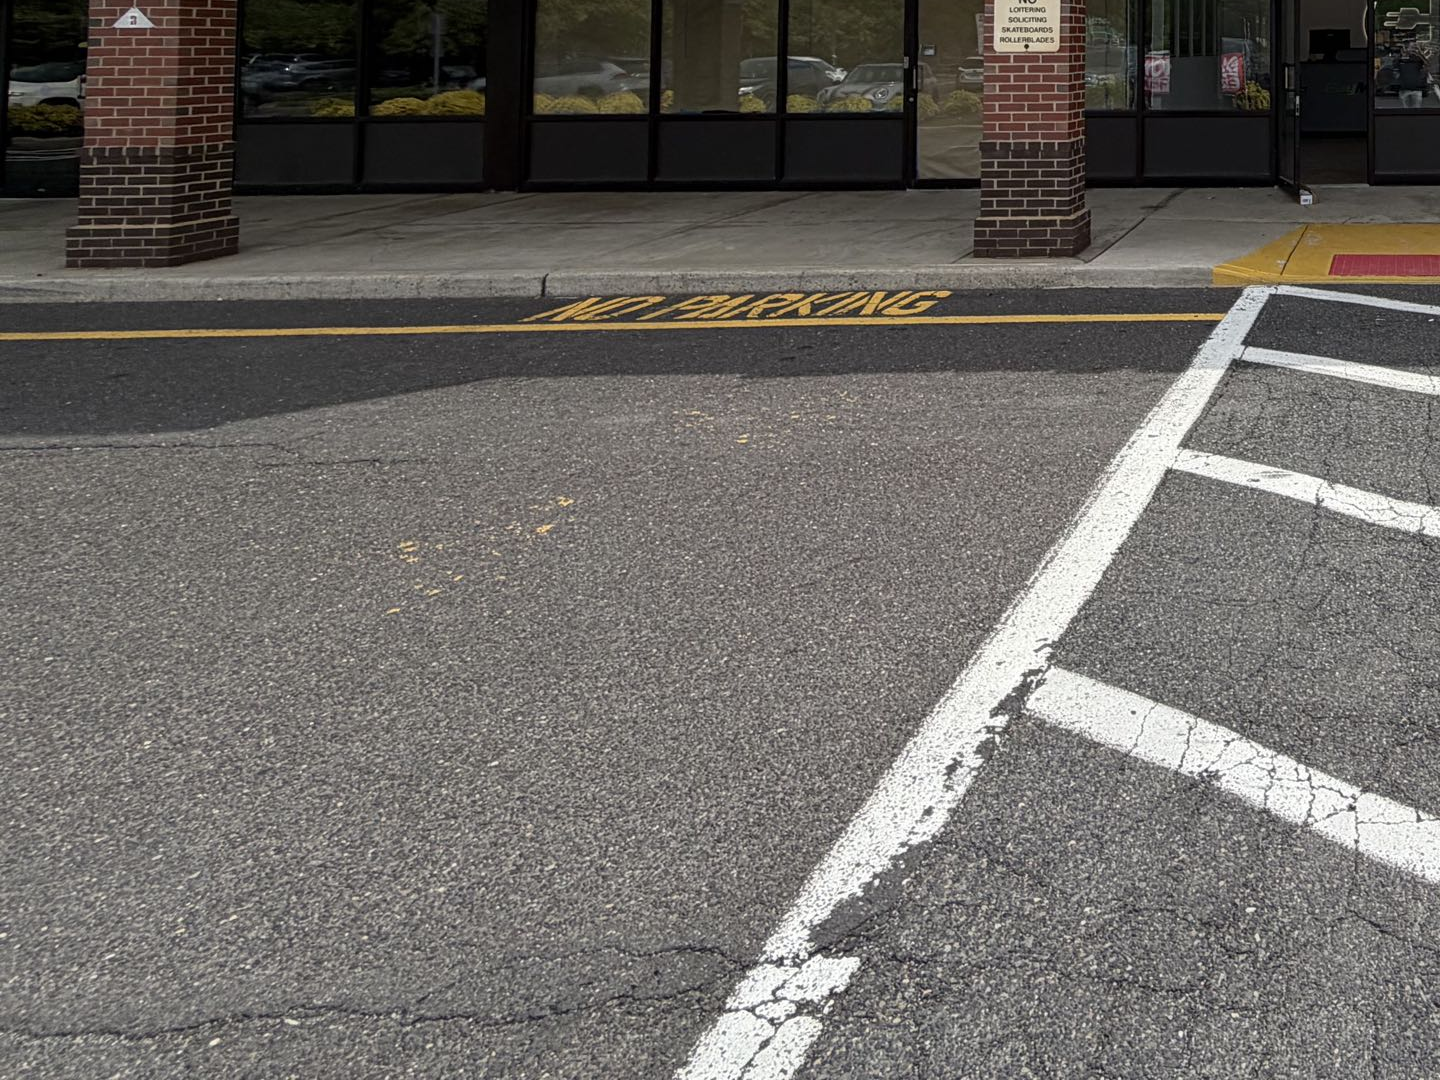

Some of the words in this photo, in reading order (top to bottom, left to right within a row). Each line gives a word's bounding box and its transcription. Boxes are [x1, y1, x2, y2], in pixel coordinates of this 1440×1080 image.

[1008, 16, 1048, 24] SOLICITING
[1001, 26, 1054, 34] SKATEBOARDS
[999, 36, 1055, 44] ROLLERBLADES
[521, 295, 666, 321] NO
[637, 289, 953, 321] PARKING
